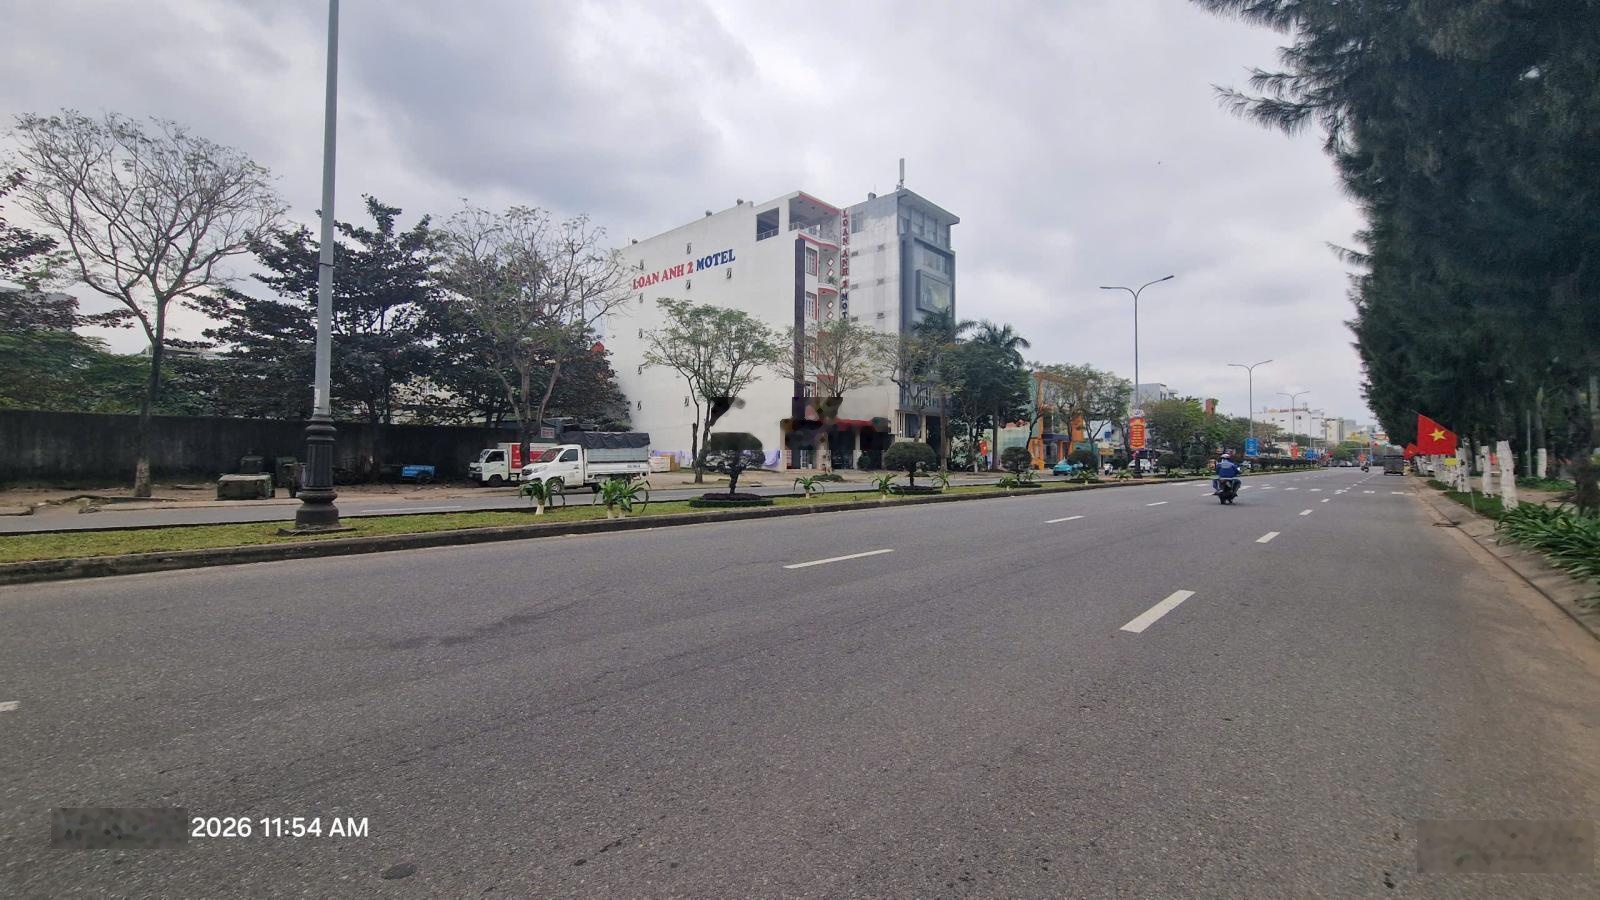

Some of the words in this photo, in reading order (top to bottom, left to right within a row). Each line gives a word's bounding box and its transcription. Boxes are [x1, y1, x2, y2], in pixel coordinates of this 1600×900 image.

[632, 272, 660, 290] LOAN
[661, 264, 685, 282] ANH
[687, 261, 694, 274] 2
[696, 249, 736, 271] MOTEL
